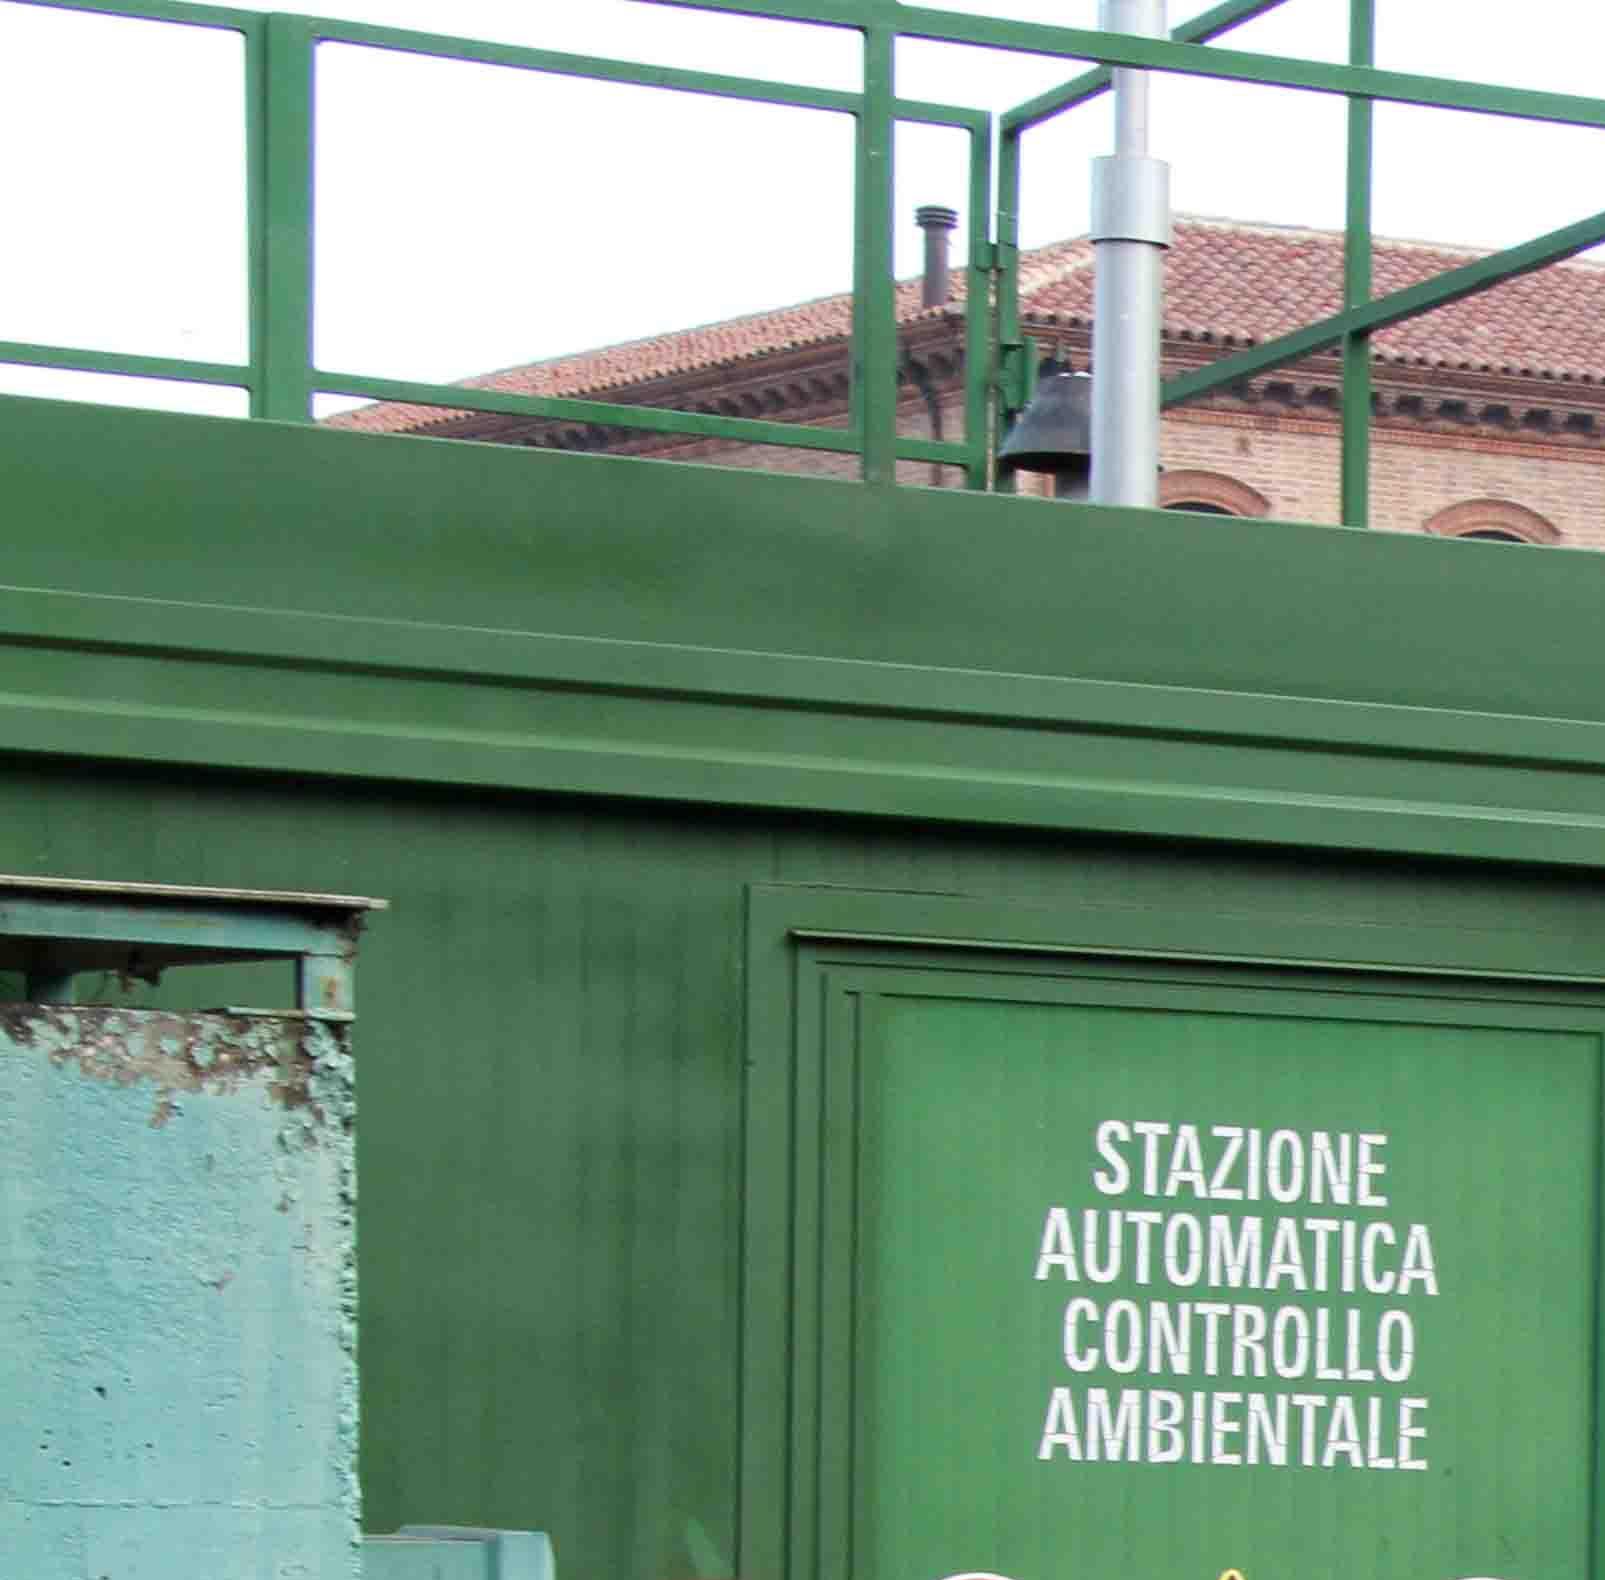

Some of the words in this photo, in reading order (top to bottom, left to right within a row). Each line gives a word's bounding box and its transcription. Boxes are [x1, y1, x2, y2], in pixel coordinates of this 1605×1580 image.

[1093, 1119, 1388, 1207] STAZIONE
[1035, 1207, 1440, 1296] AUTOMATICA
[1064, 1297, 1414, 1383] CONTROLLO
[1037, 1387, 1429, 1471] AMBIENTALE
